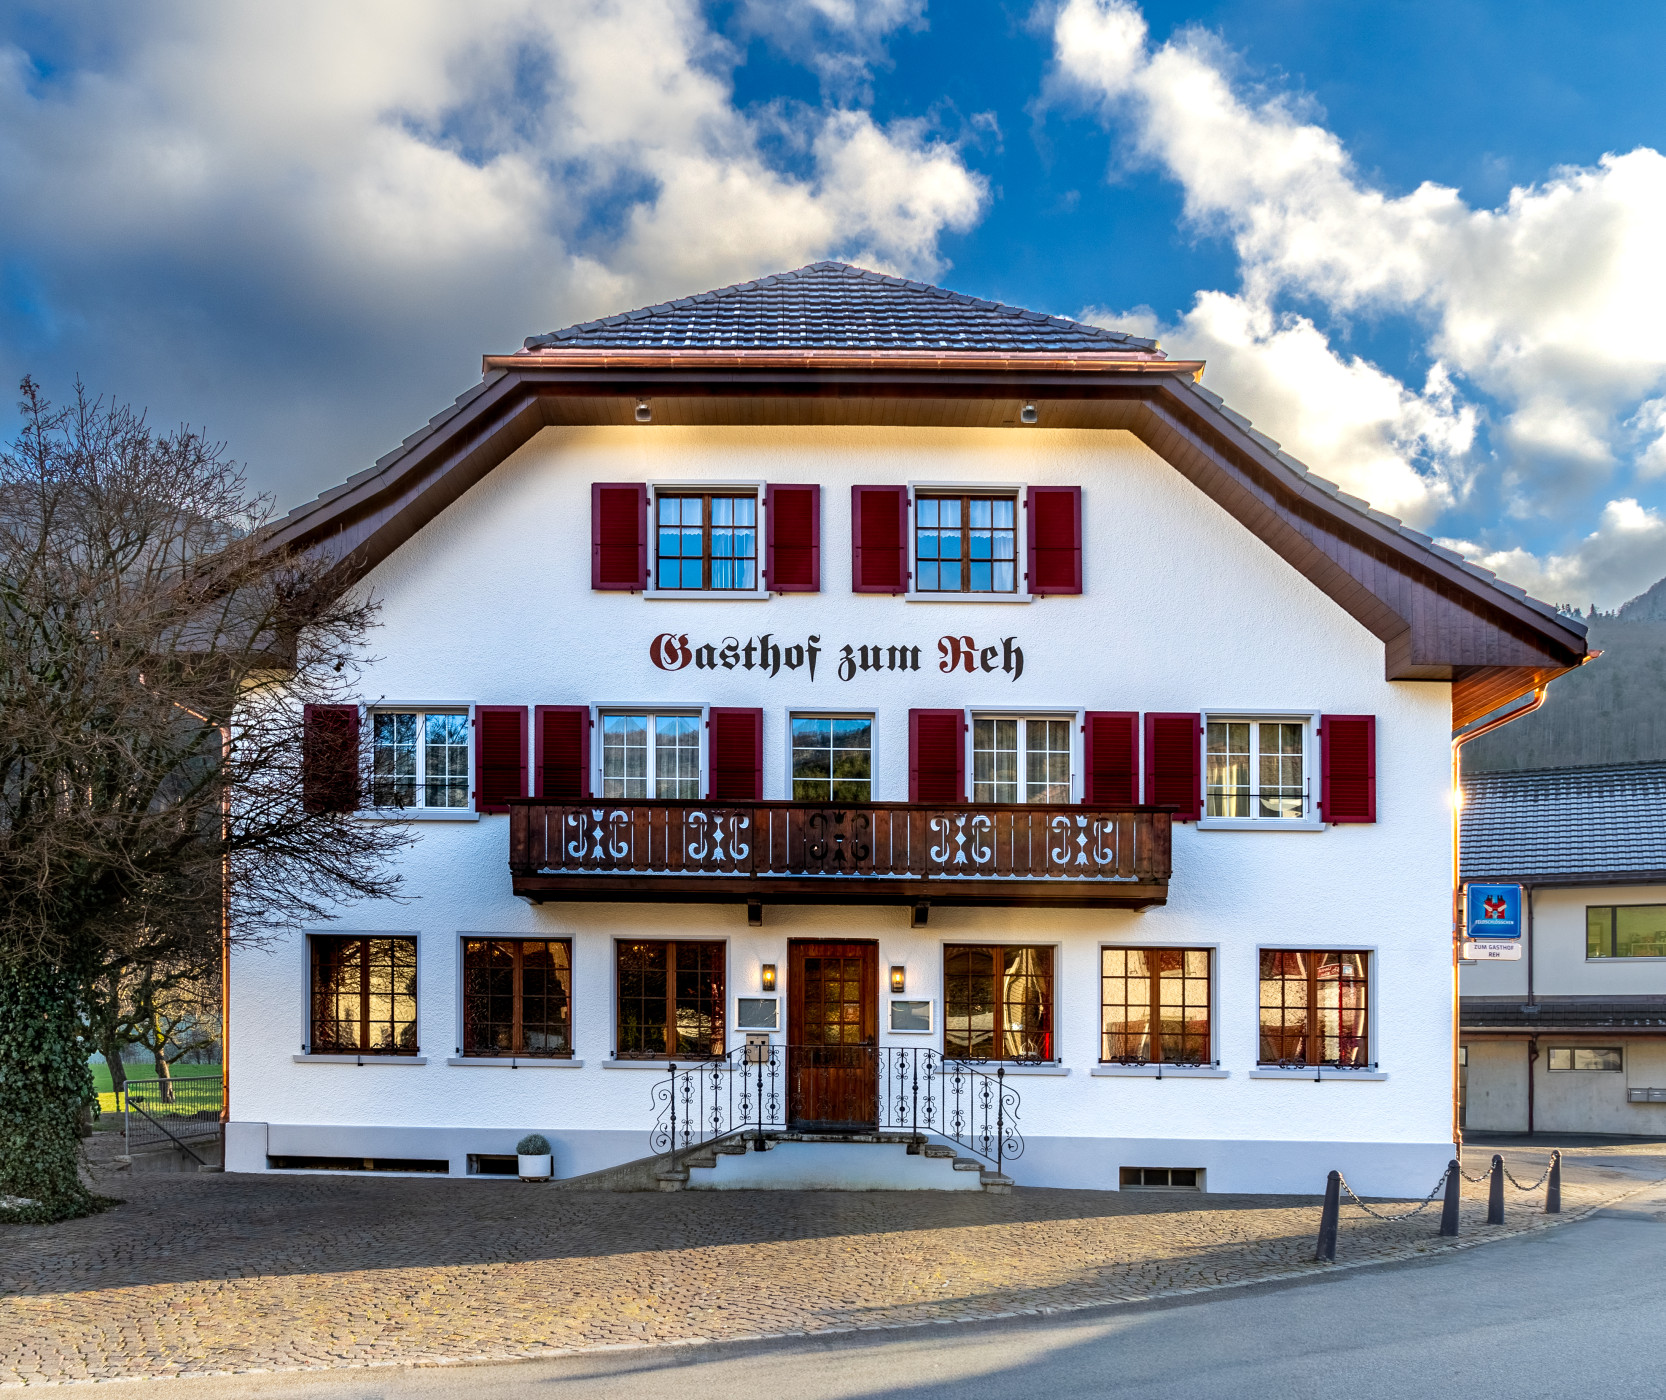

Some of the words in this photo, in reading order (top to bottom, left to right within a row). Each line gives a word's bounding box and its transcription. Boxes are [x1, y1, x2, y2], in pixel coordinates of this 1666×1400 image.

[649, 633, 821, 682] Gasthof
[837, 643, 922, 682] zum
[937, 635, 1024, 682] Reh
